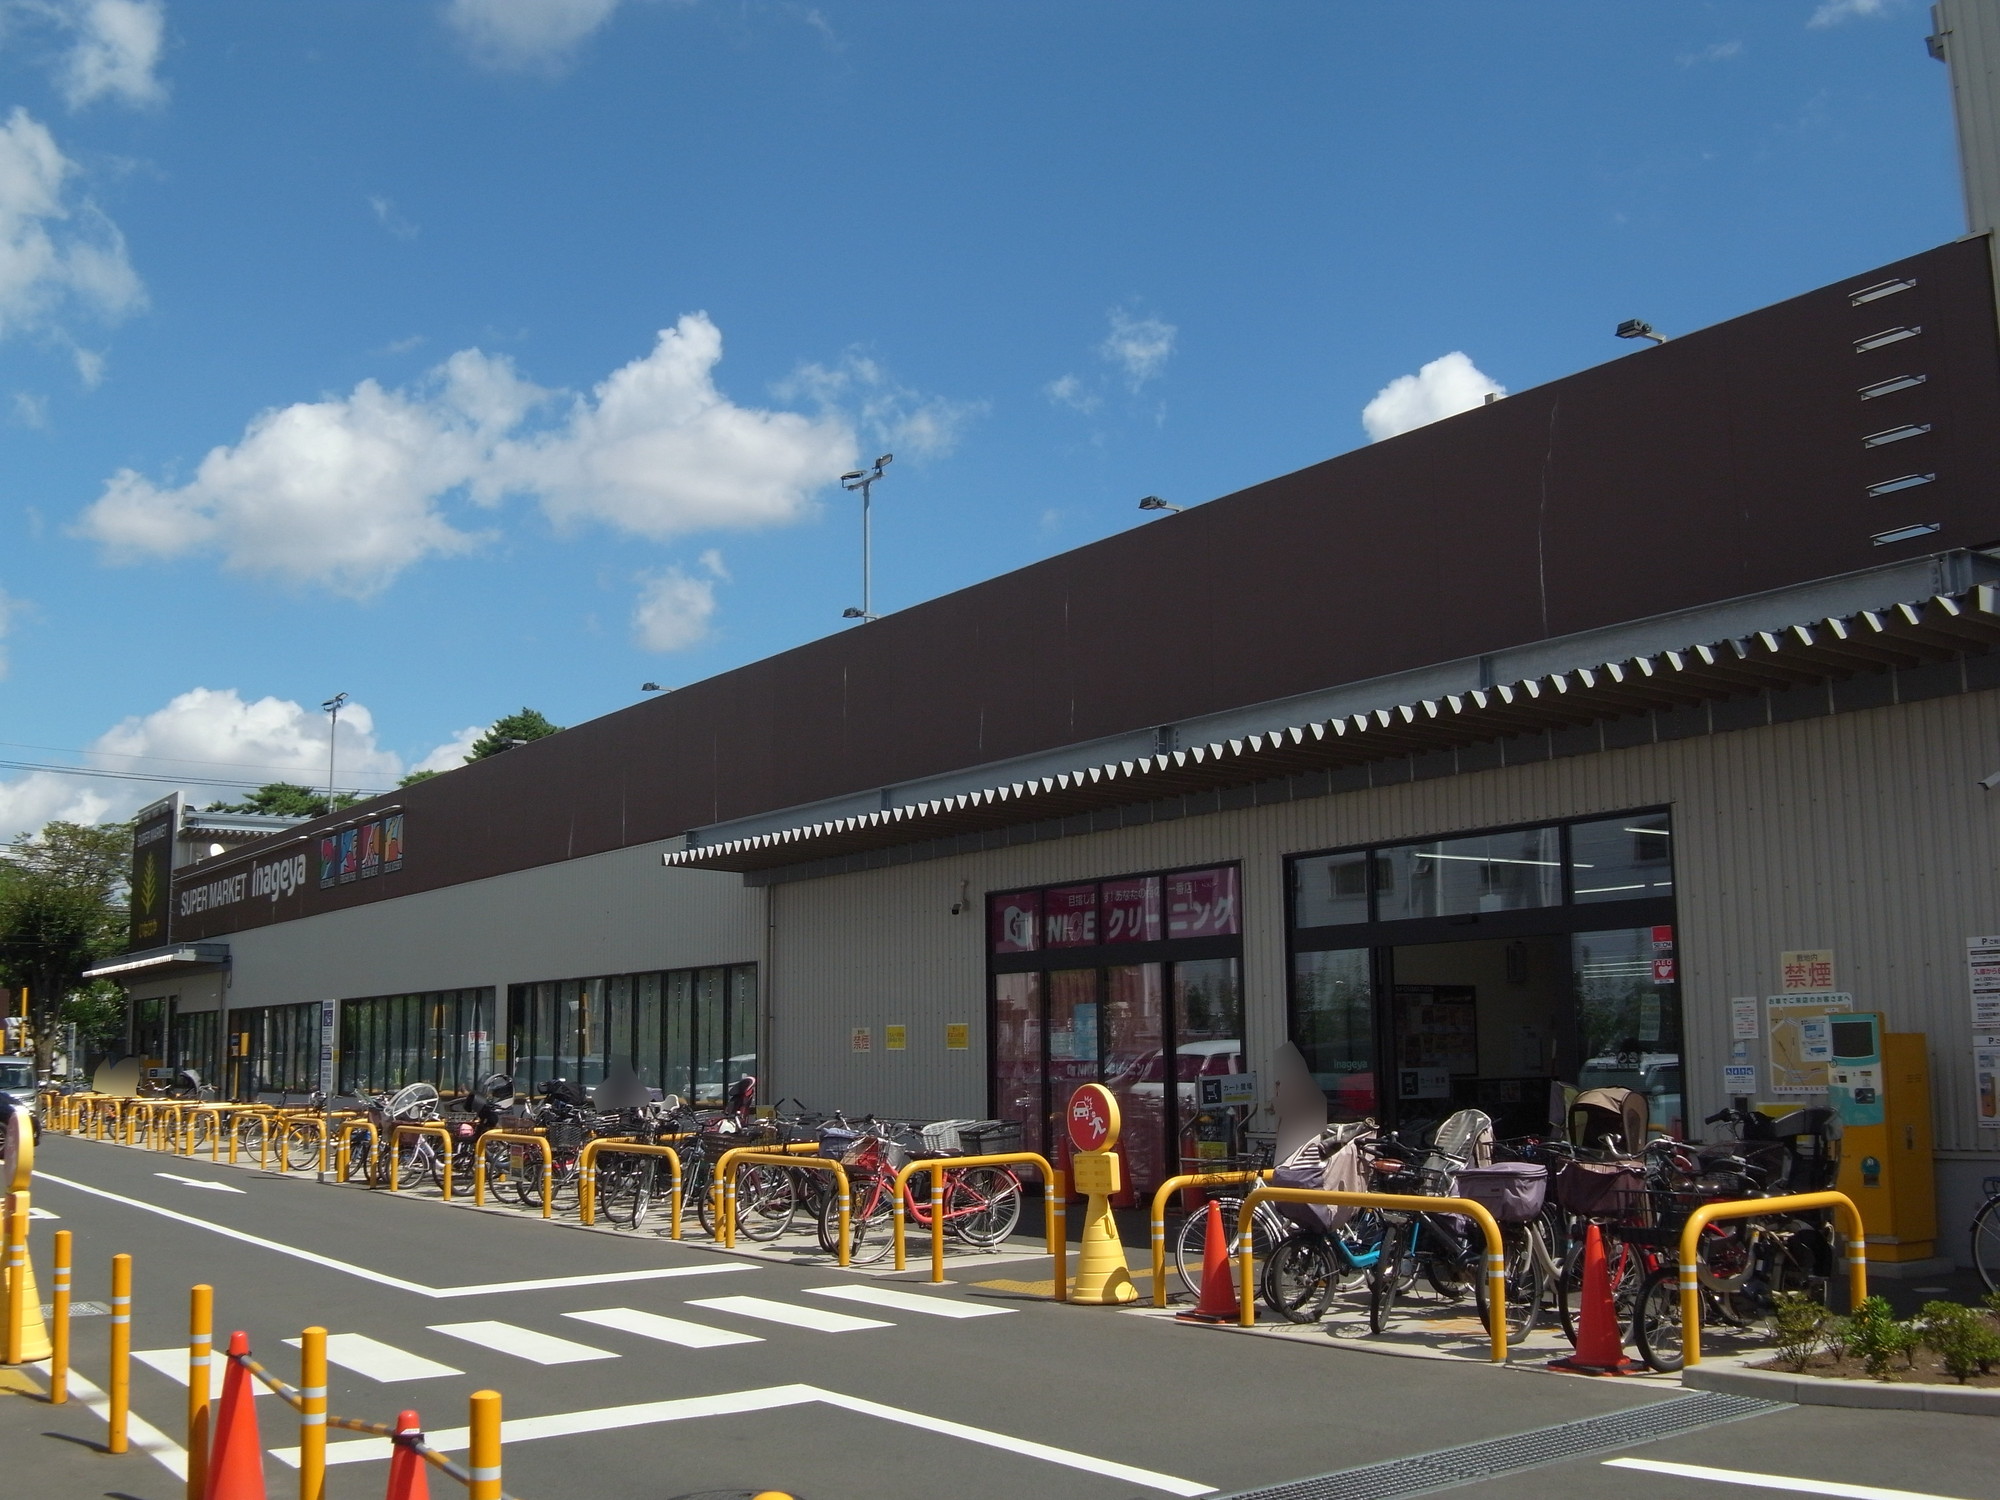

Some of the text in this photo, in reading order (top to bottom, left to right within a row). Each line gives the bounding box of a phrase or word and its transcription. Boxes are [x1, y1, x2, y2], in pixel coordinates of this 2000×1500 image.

[181, 854, 306, 916] SUPER MARKET inageya
[1047, 896, 1235, 943] NICE クリーニング
[1785, 962, 1832, 988] 禁煙
